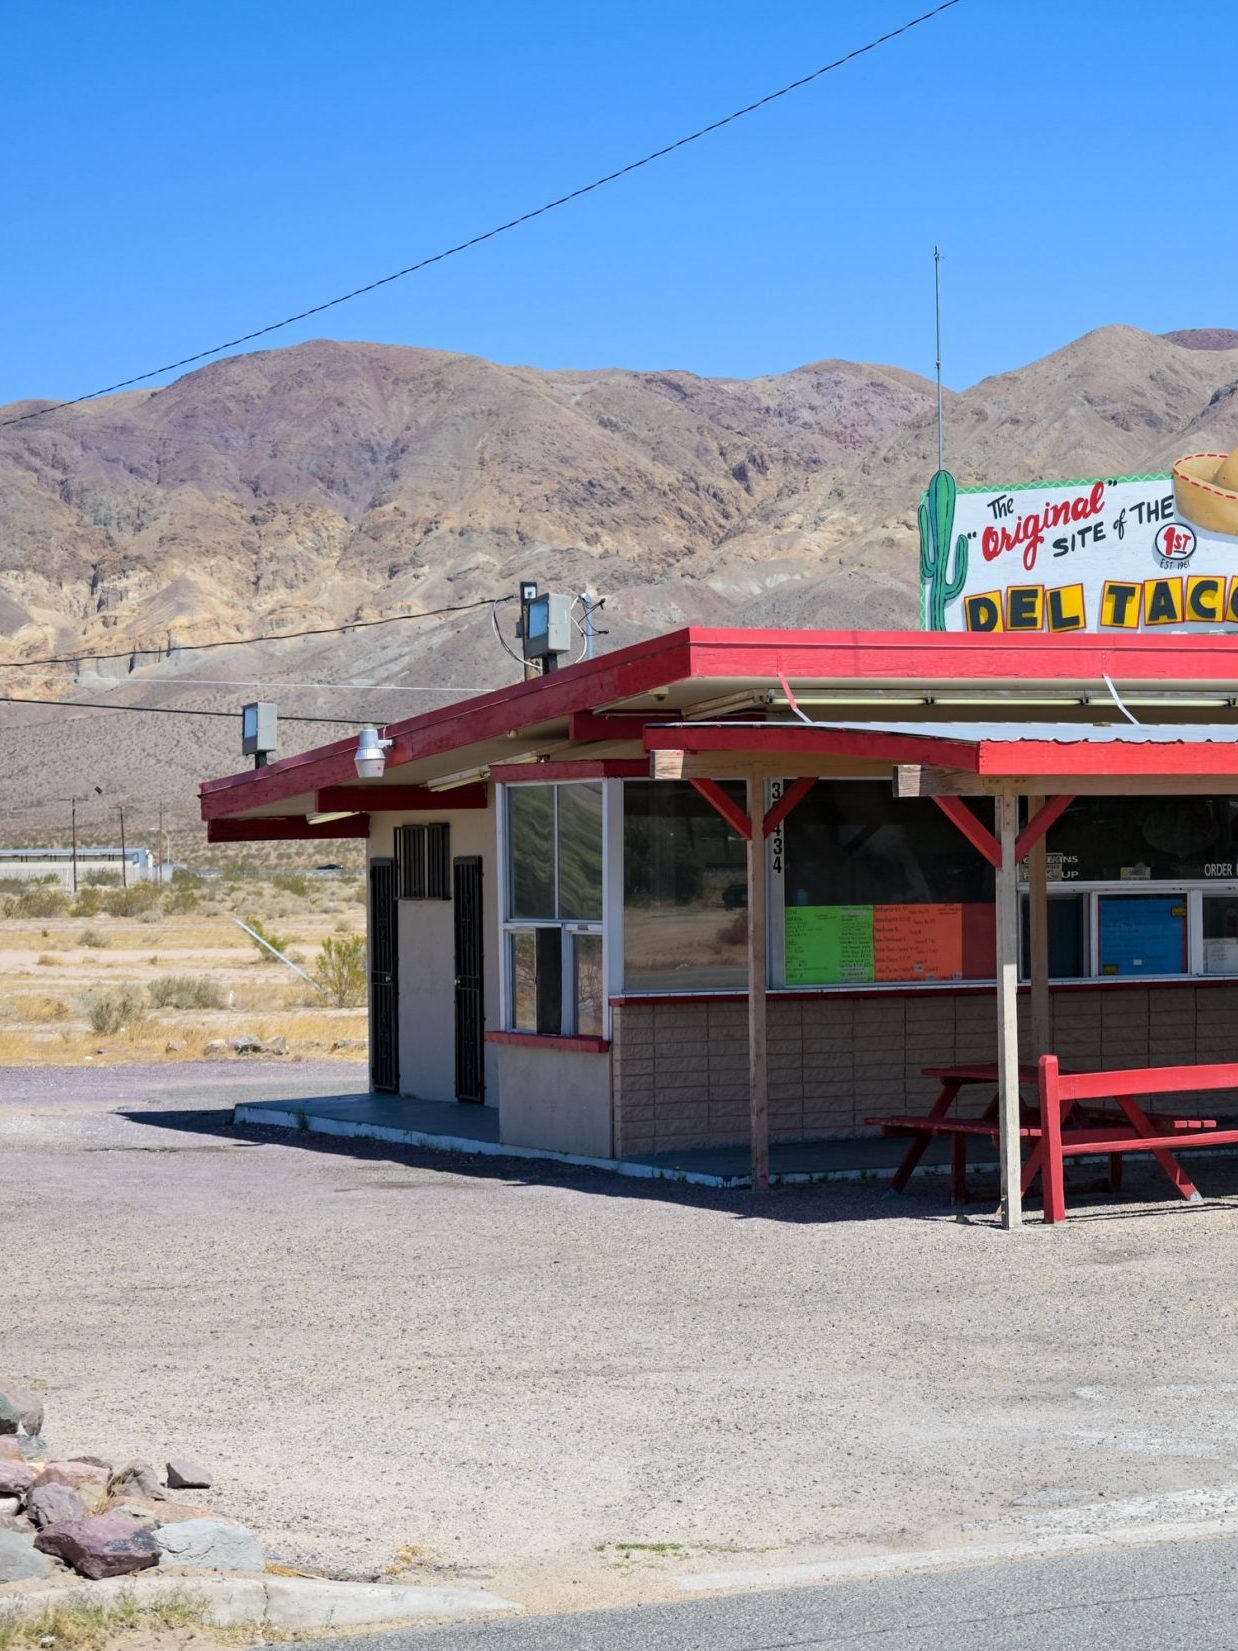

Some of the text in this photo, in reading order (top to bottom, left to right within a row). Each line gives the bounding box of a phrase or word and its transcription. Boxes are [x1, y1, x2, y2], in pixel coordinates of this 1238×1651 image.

[987, 494, 1014, 520] The
[1052, 494, 1174, 557] SITE of THE
[1163, 526, 1192, 556] 1ST
[968, 588, 1080, 632] DEL
[1204, 863, 1233, 877] ORDER
